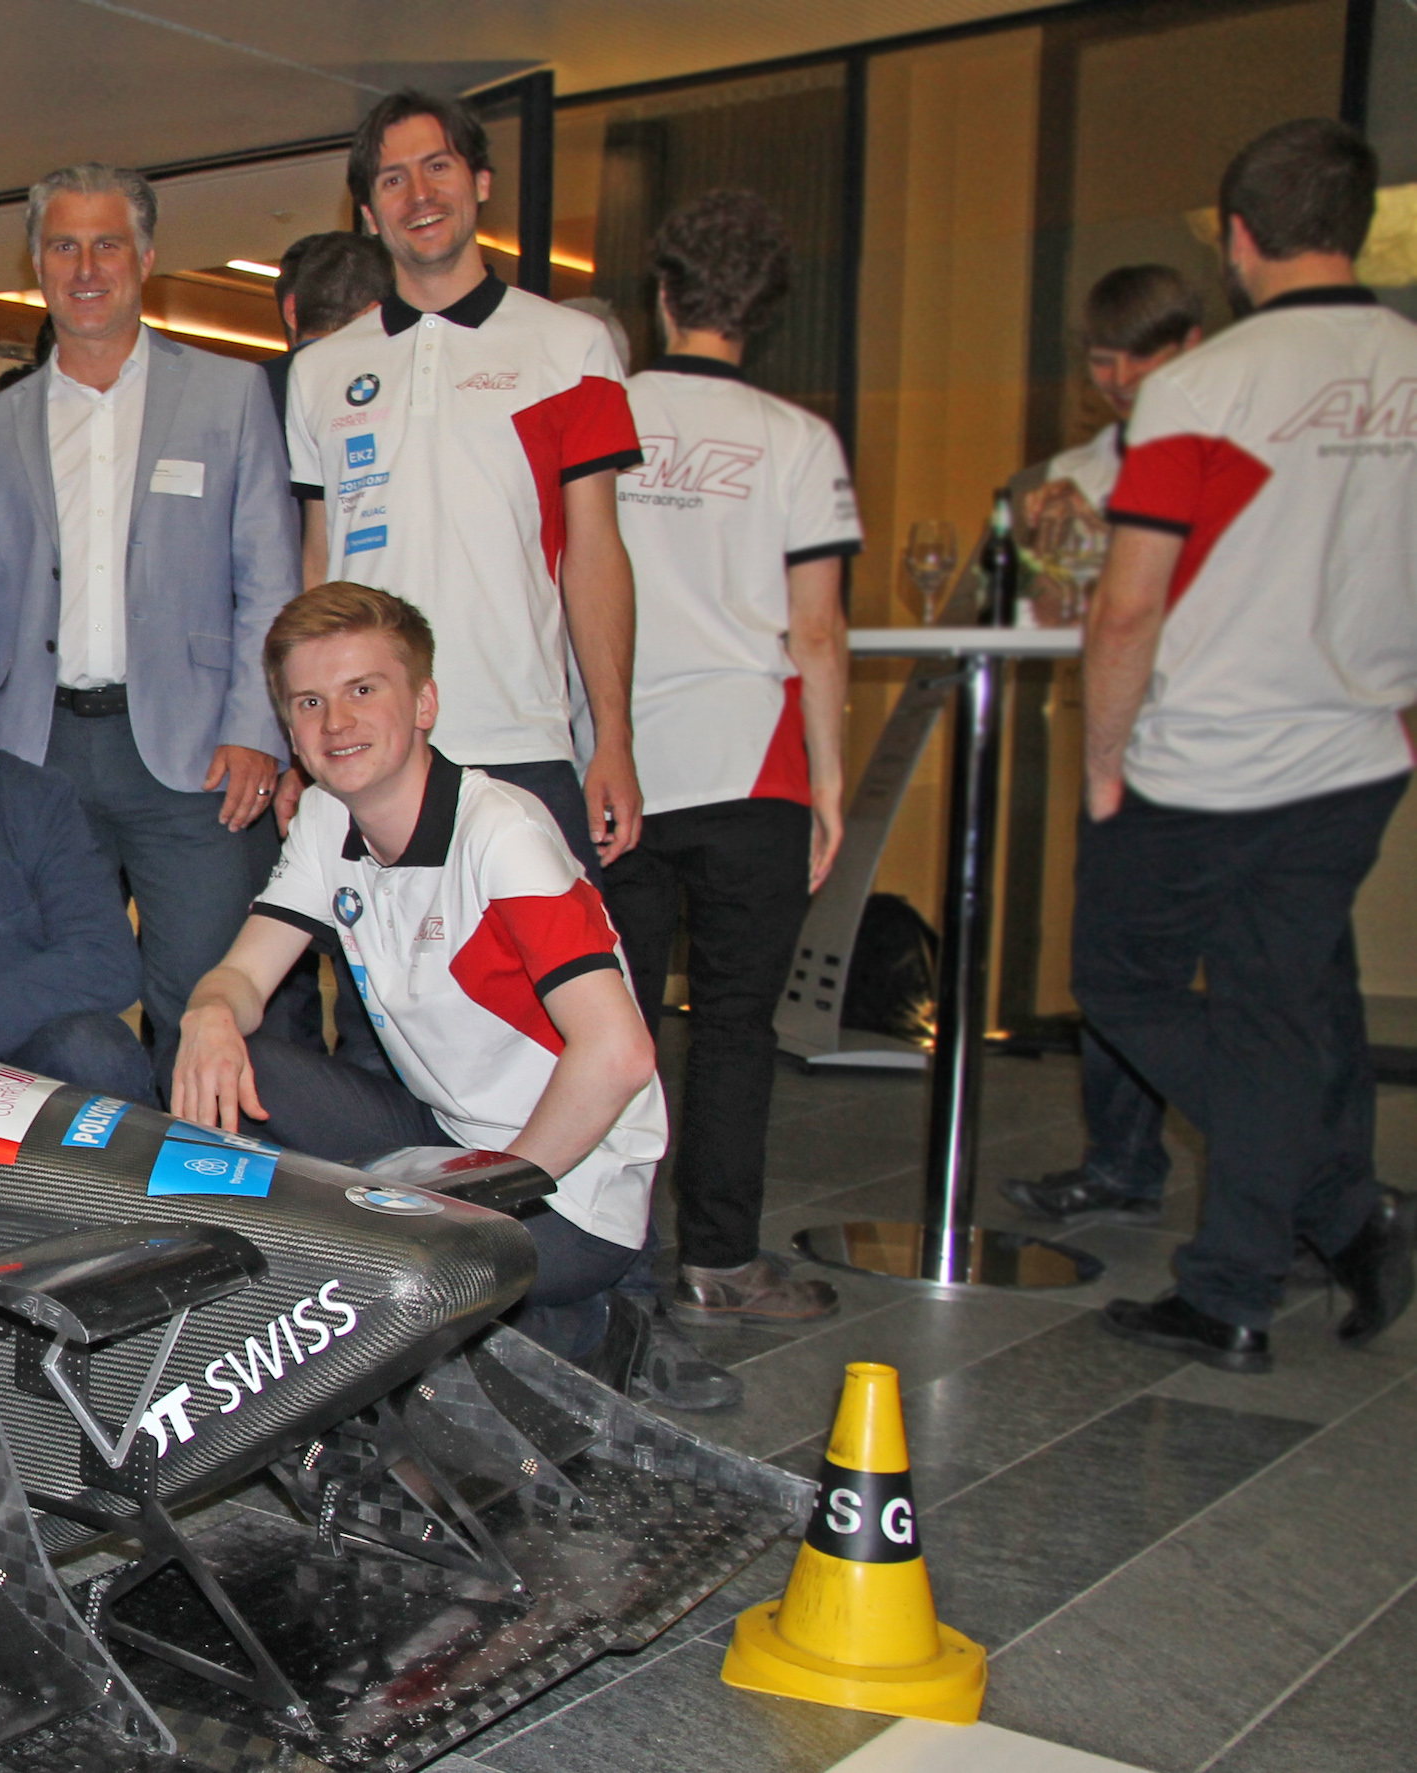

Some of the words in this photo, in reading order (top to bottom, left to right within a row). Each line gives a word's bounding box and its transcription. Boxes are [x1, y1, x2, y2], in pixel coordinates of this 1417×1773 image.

[349, 448, 374, 463] EKZ
[414, 916, 445, 941] MZ
[72, 1096, 128, 1145] POLYGON
[204, 1279, 358, 1414] SWISS
[814, 1484, 863, 1535] S
